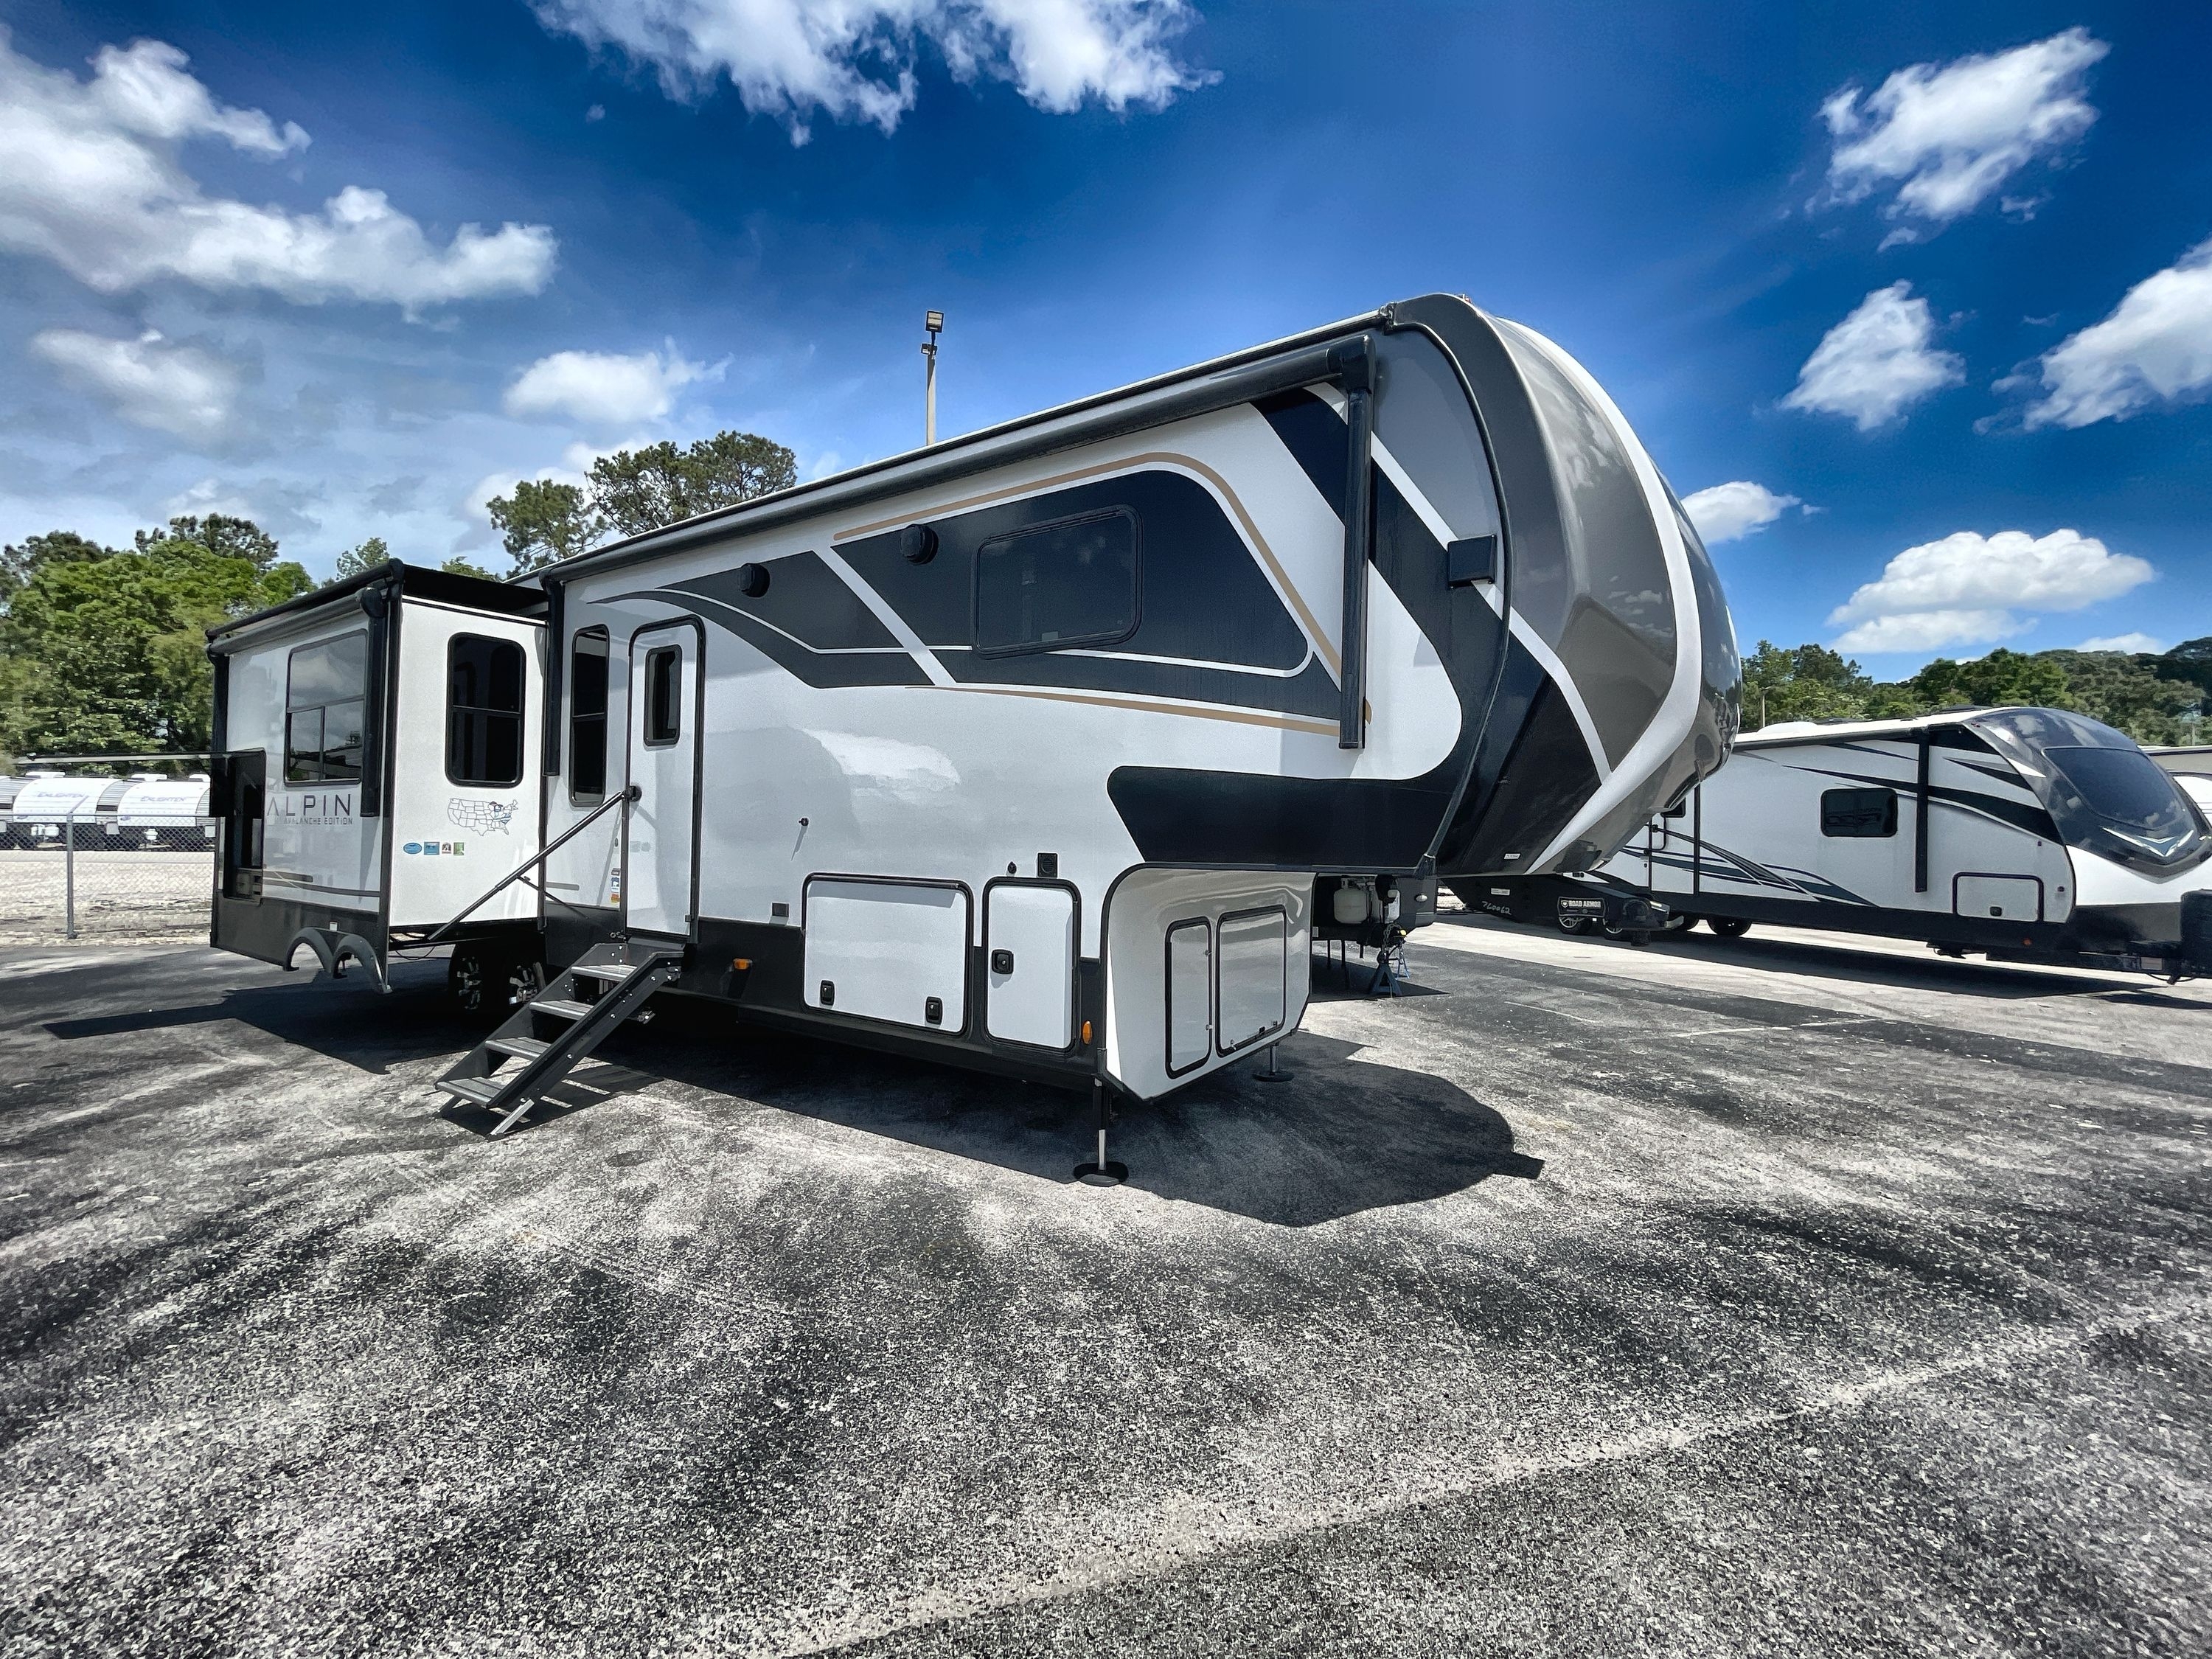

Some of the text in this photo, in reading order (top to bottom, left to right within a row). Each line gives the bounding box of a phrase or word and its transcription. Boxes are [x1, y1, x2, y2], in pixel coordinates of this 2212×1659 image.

[283, 817, 352, 825] AVALANCHE EDITION
[1582, 900, 1601, 908] ARMOR
